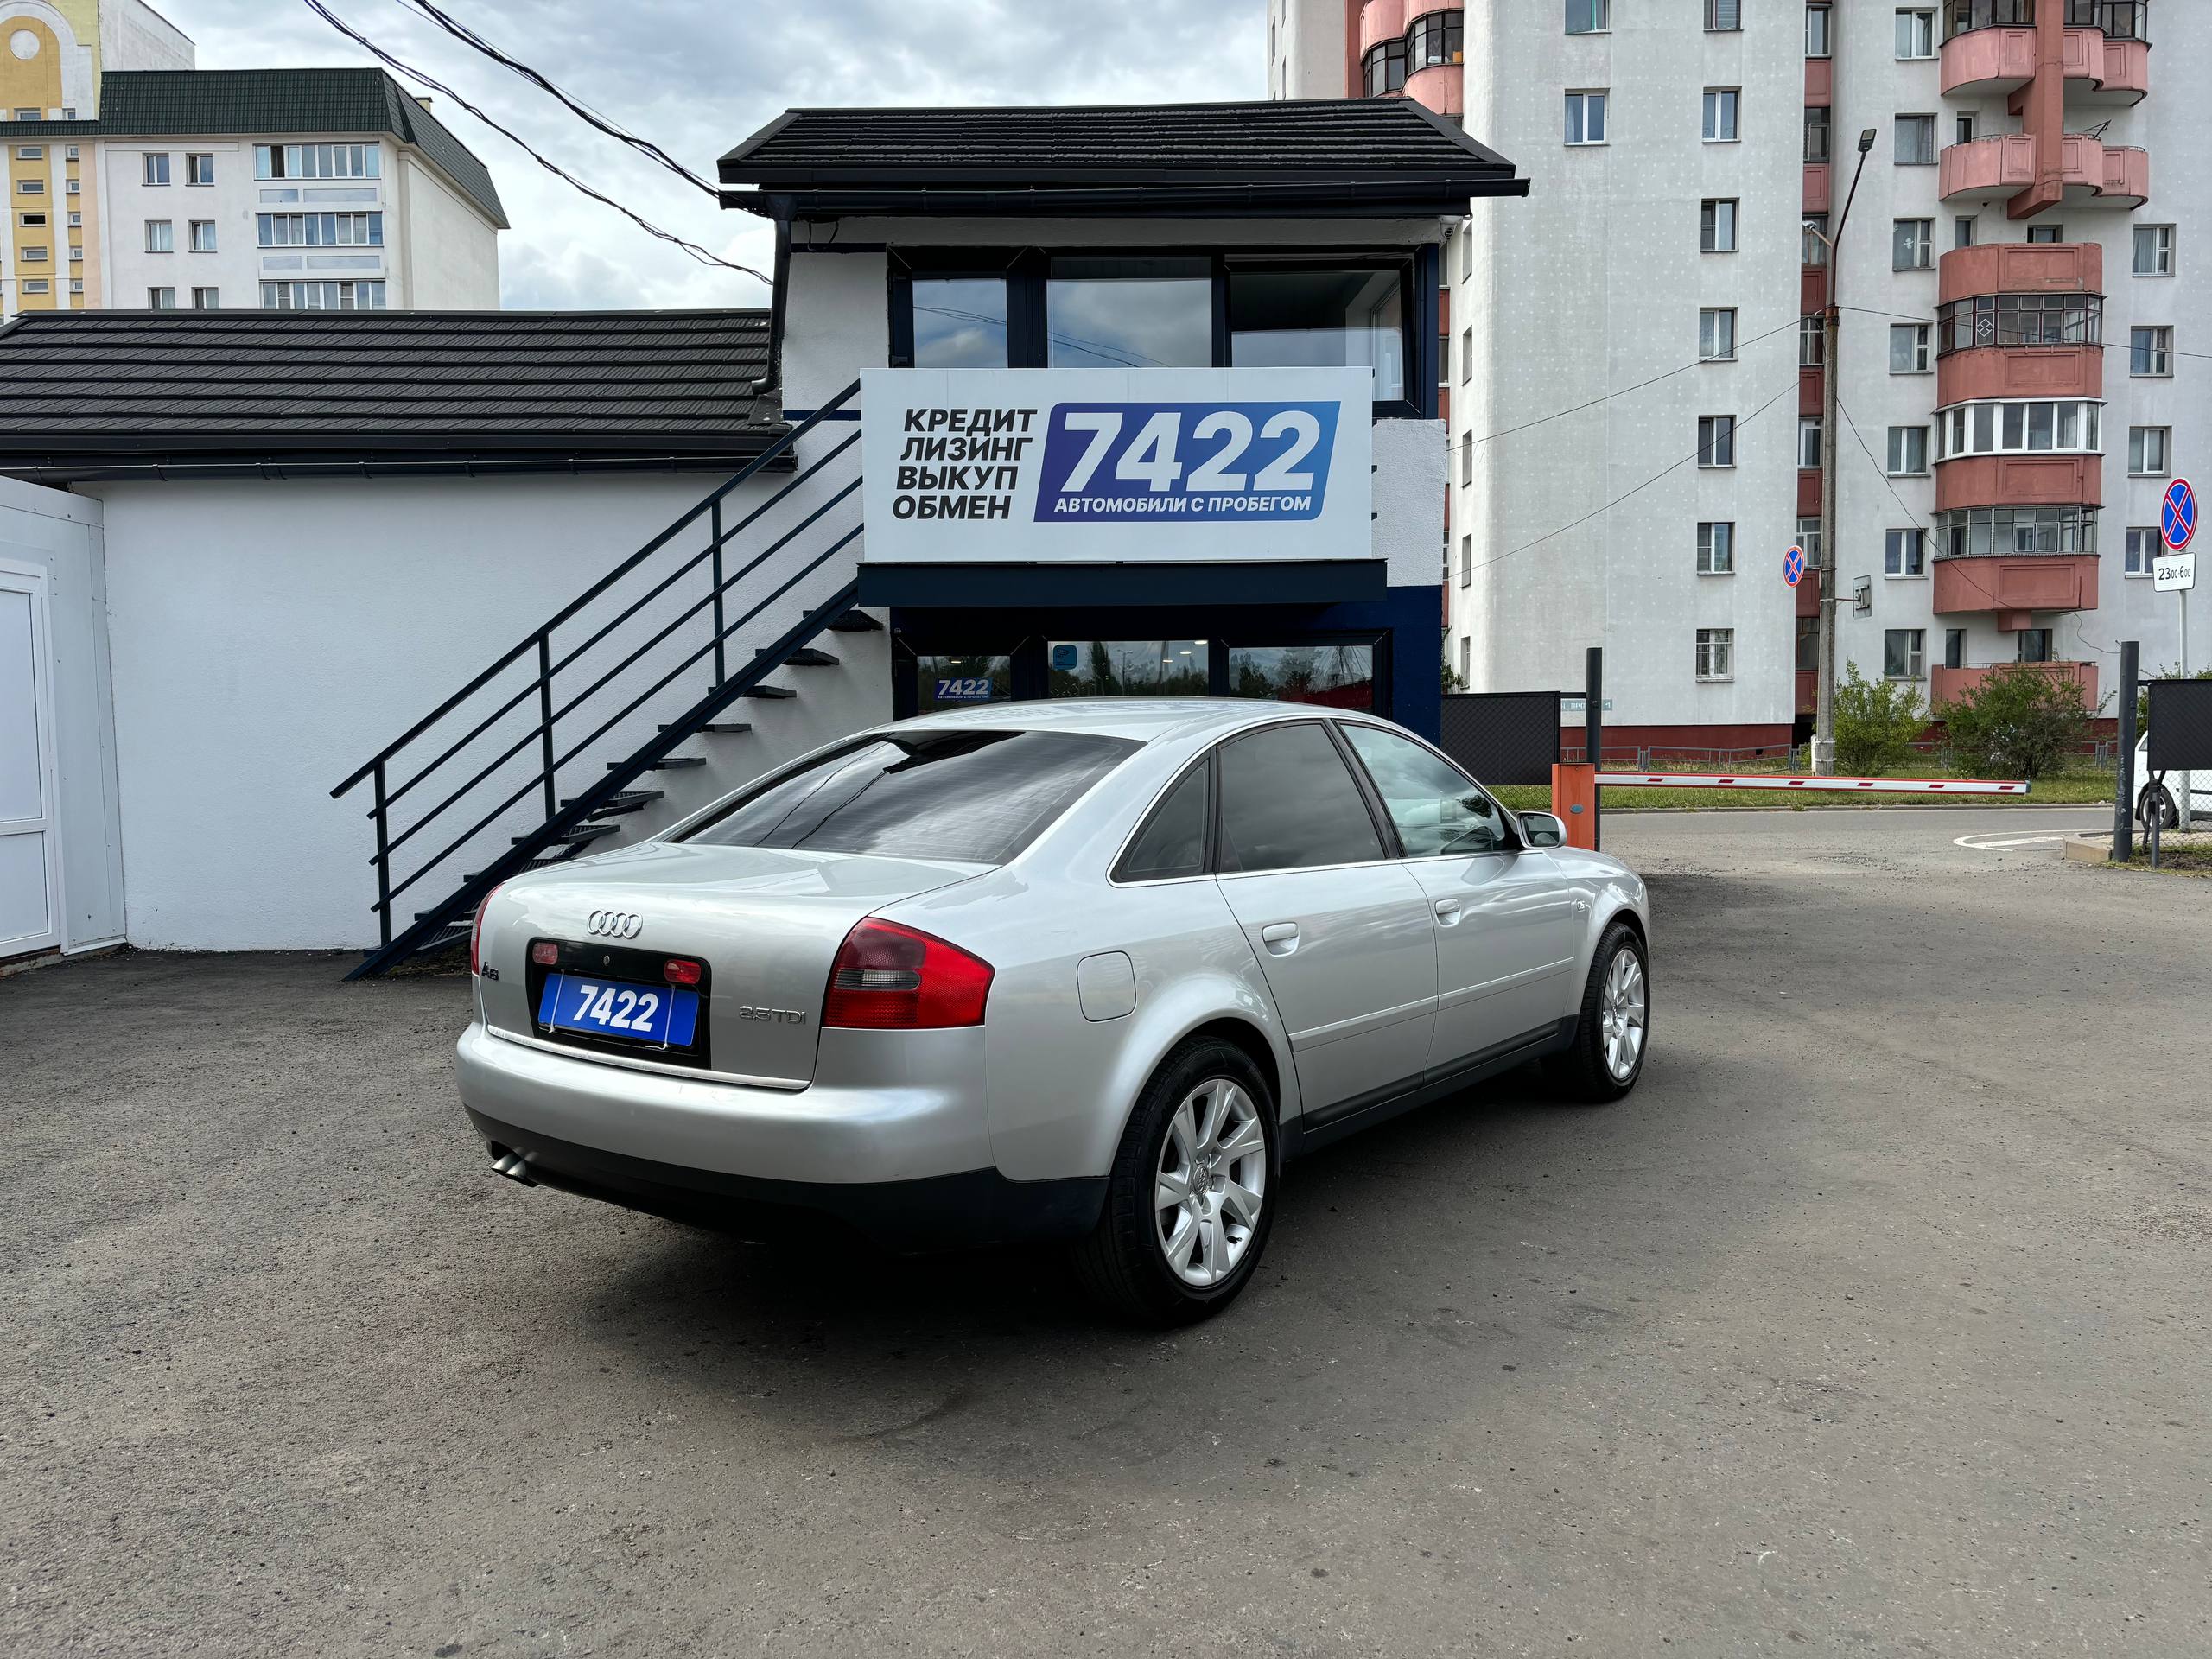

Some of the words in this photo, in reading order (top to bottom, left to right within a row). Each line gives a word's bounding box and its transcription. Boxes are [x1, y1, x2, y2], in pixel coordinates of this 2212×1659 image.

[904, 409, 1038, 437] КРЕДИТ
[899, 437, 1033, 461] ЛИЗИНГ
[1060, 410, 1321, 492] 7422
[896, 466, 1019, 490] ВЫКУП
[893, 495, 1012, 519] ОБМЕН
[1053, 497, 1187, 512] АВТОМОБИЛИ
[1190, 497, 1205, 512] С
[1207, 496, 1312, 512] ПРОБЕГОМ
[938, 679, 989, 695] 7422
[572, 985, 658, 1033] 7422
